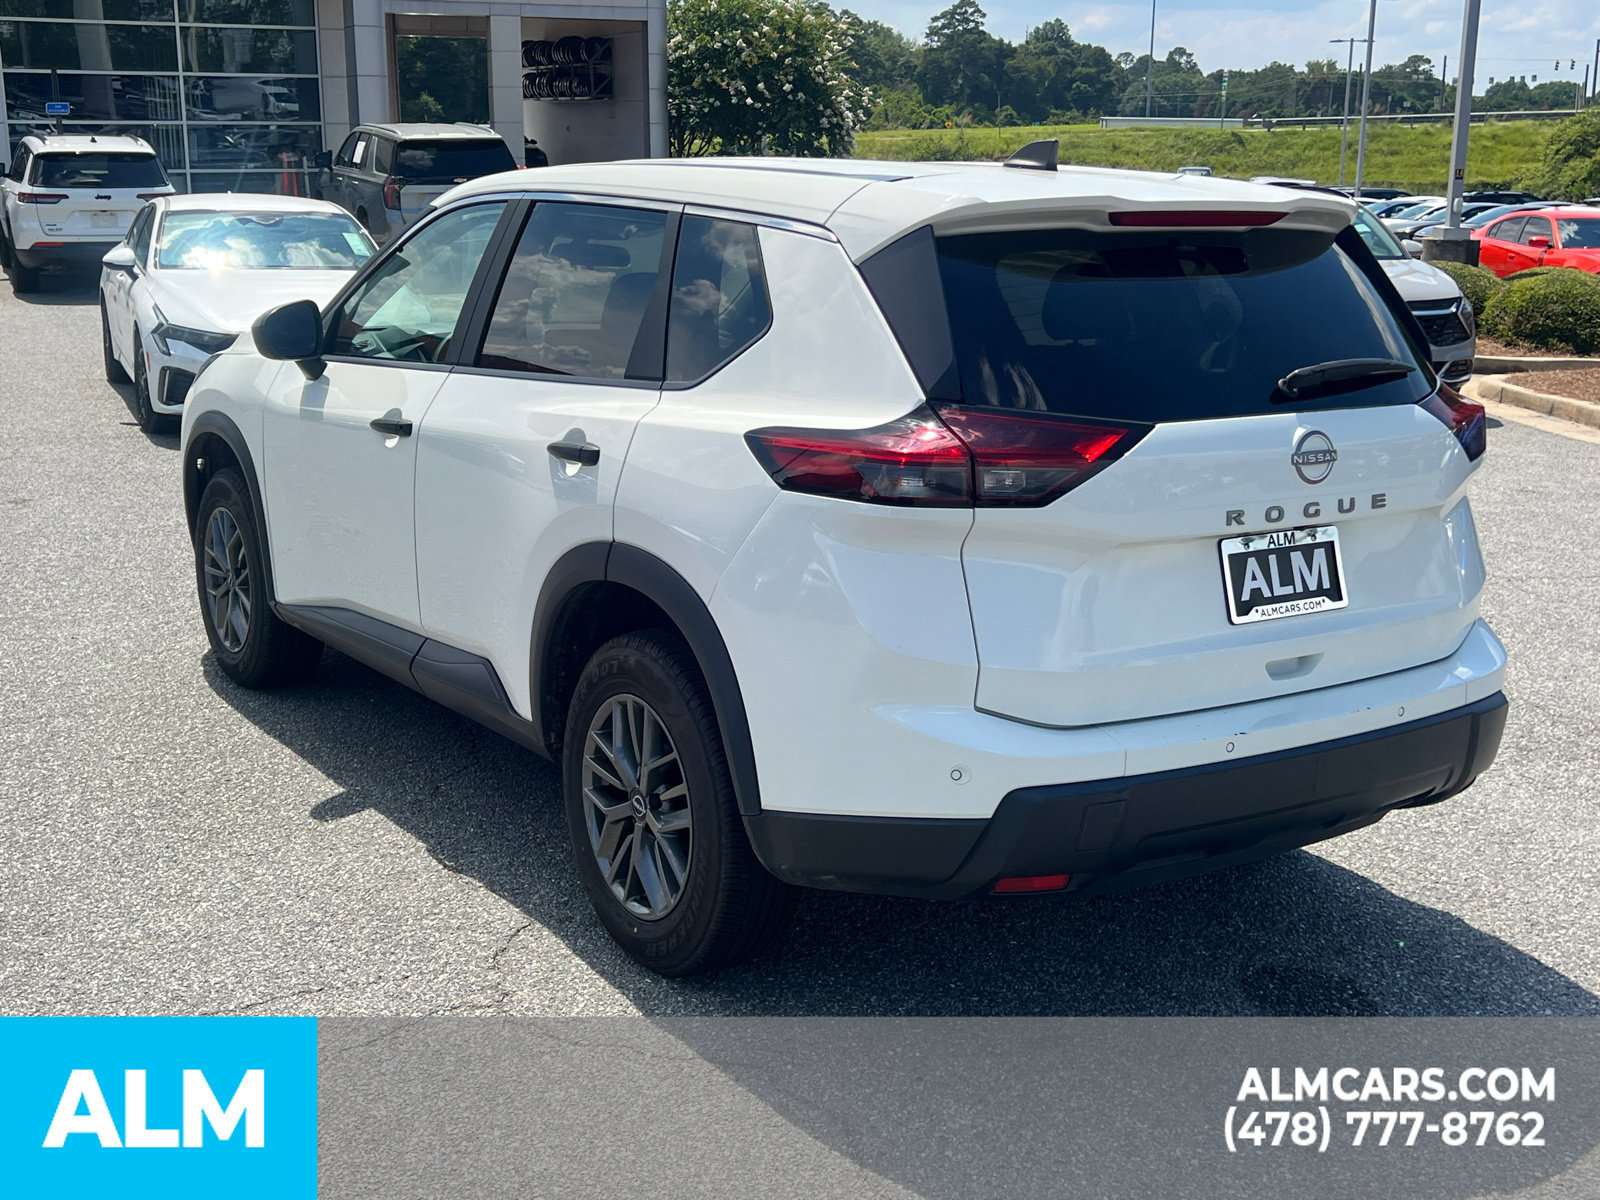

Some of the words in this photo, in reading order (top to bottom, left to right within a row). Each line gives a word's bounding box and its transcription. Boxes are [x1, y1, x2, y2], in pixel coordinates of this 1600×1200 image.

[1293, 452, 1338, 464] NISSAN
[1226, 493, 1387, 526] ROGUE
[1267, 532, 1296, 548] ALM
[1241, 548, 1331, 601] ALM
[1260, 602, 1322, 618] ALMCARS.COM
